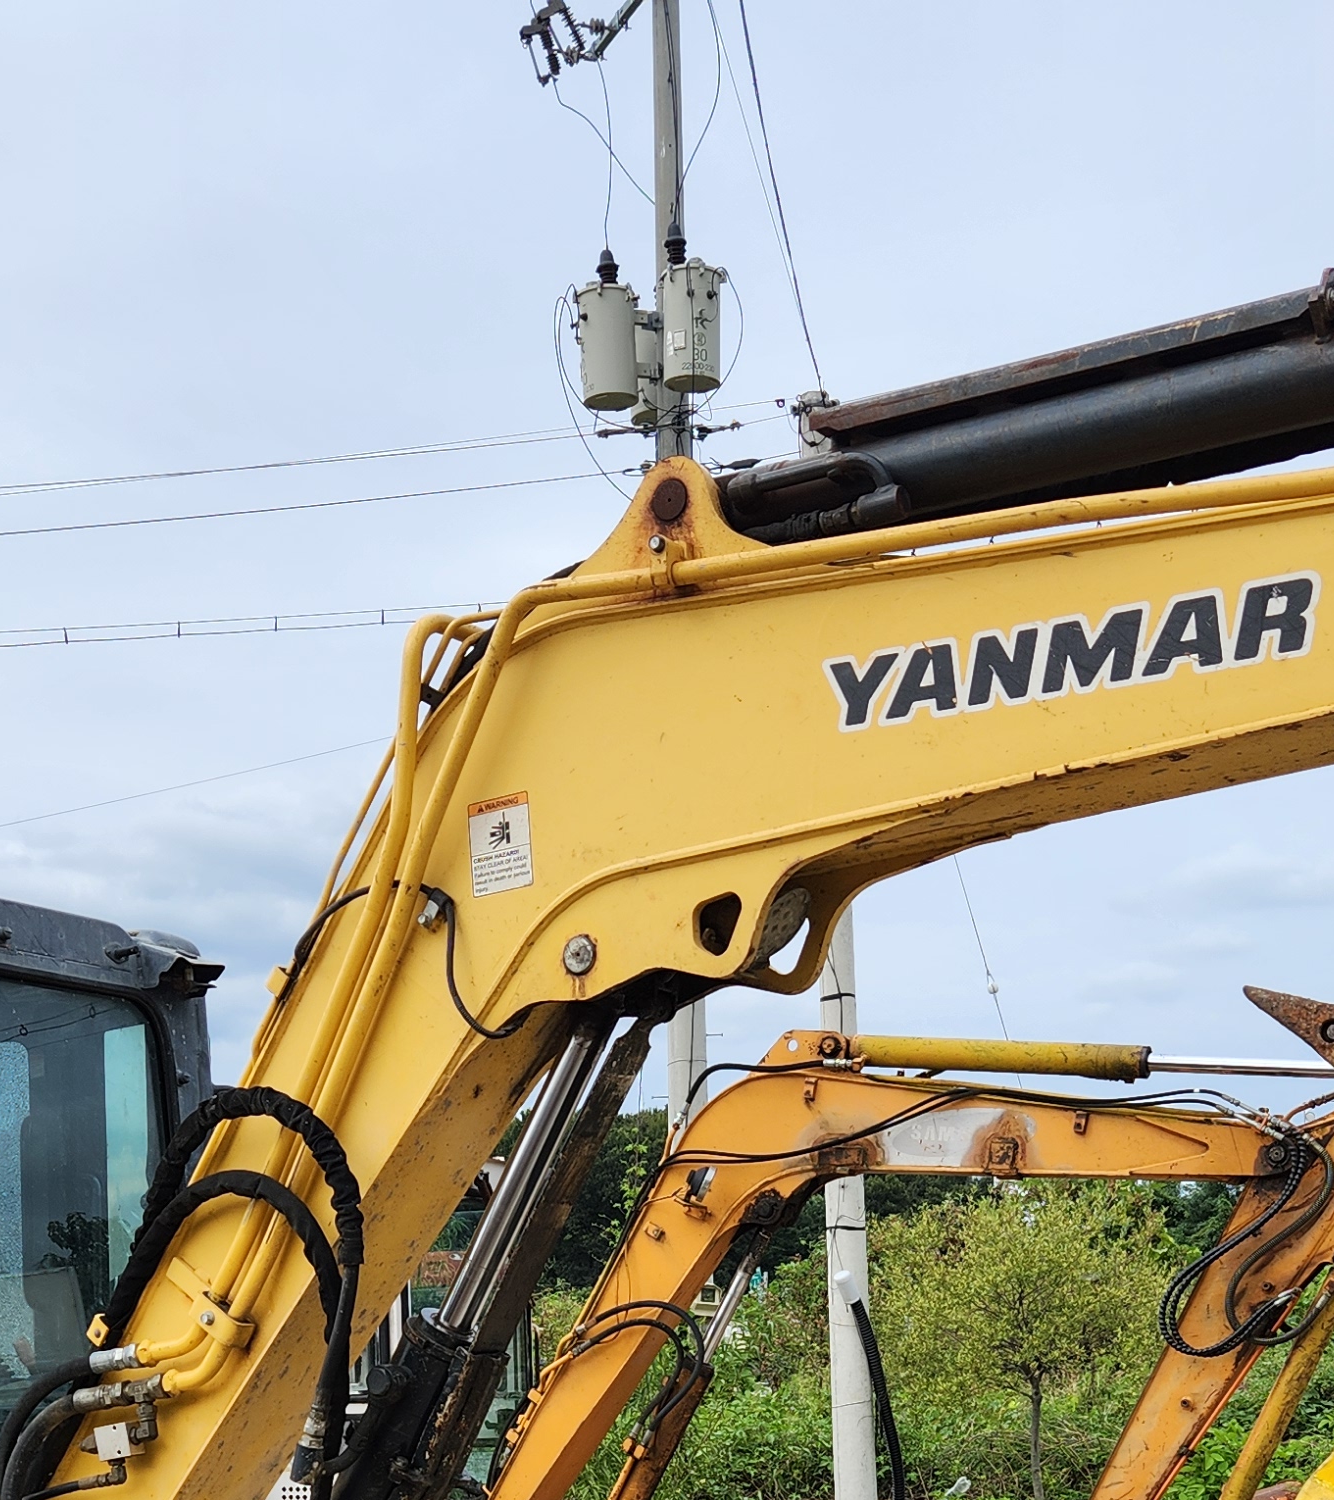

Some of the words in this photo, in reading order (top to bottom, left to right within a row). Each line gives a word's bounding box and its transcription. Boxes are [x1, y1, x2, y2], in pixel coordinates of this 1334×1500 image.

[828, 576, 1315, 728] YANMAR
[484, 796, 519, 810] WARNING
[487, 859, 504, 868] CLEAR
